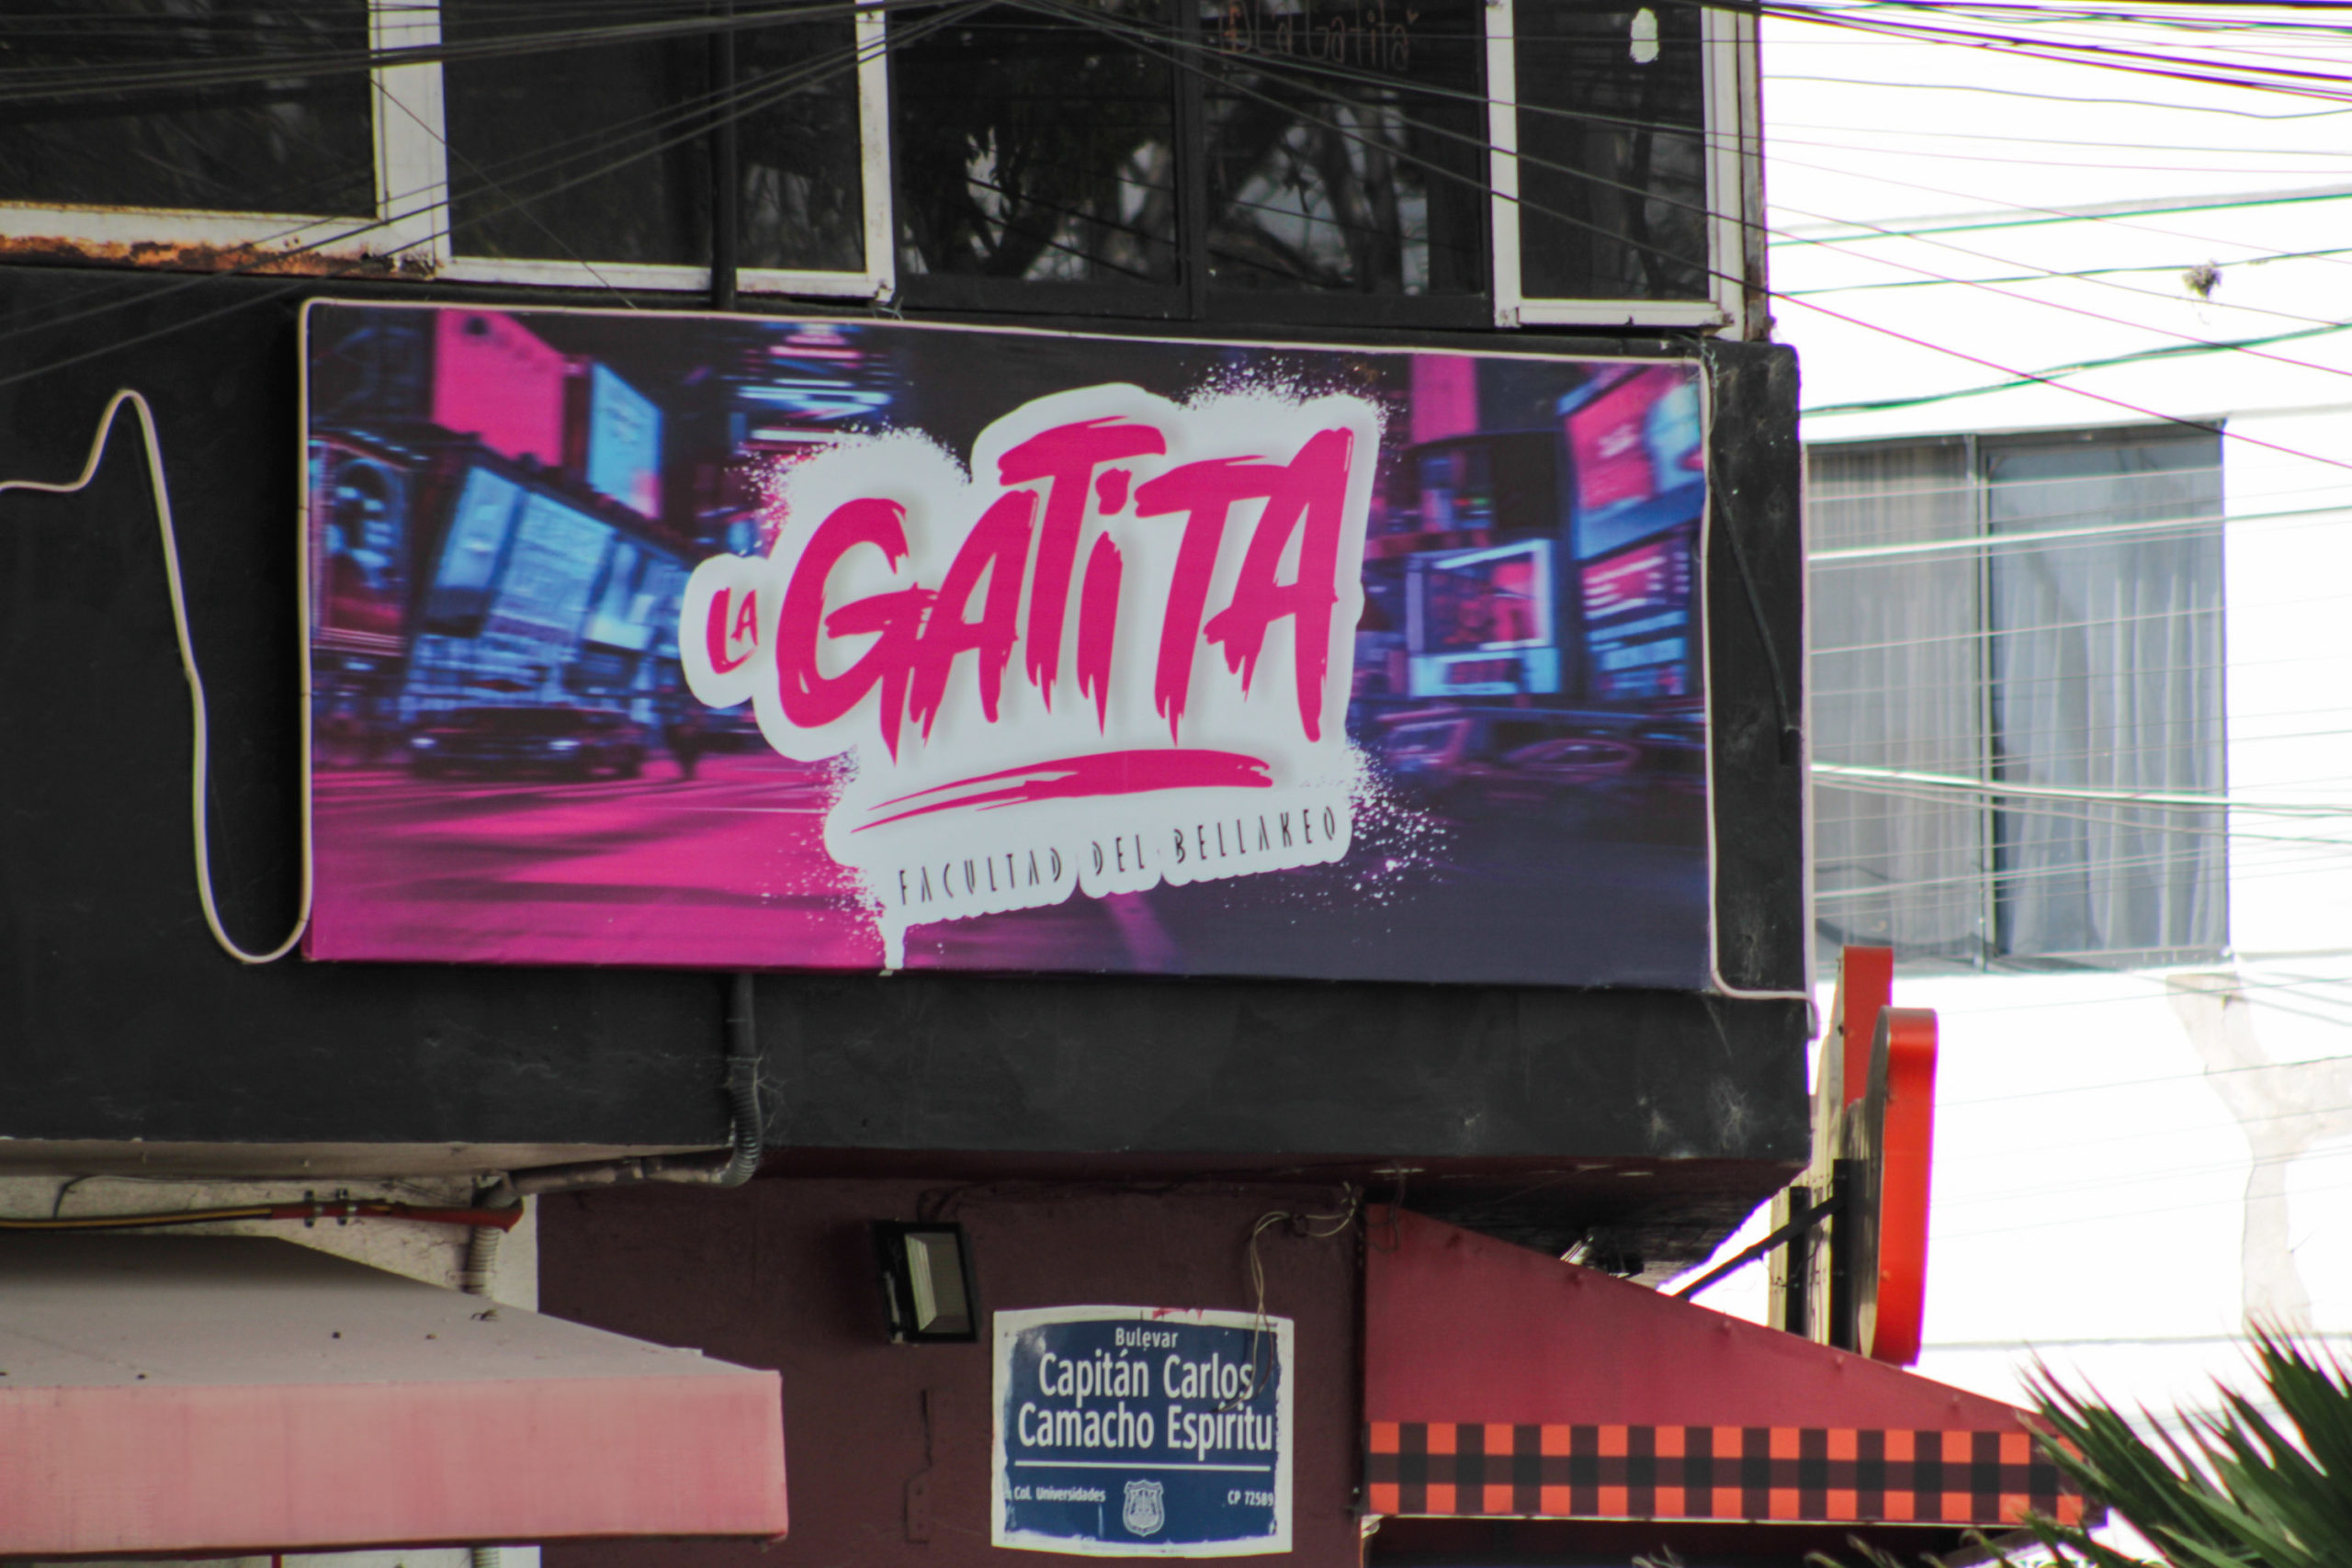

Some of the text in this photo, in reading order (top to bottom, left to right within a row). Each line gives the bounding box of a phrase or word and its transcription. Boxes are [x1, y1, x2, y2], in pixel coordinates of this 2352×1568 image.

[707, 587, 758, 675] LA
[899, 806, 1336, 905] FACULTAD DEL BELLAKEO
[1114, 1327, 1179, 1348] Bulevar
[1038, 1348, 1254, 1408] Capitán Carlos
[1018, 1401, 1272, 1461] Camacho Espíritu
[1227, 1489, 1241, 1505] CP
